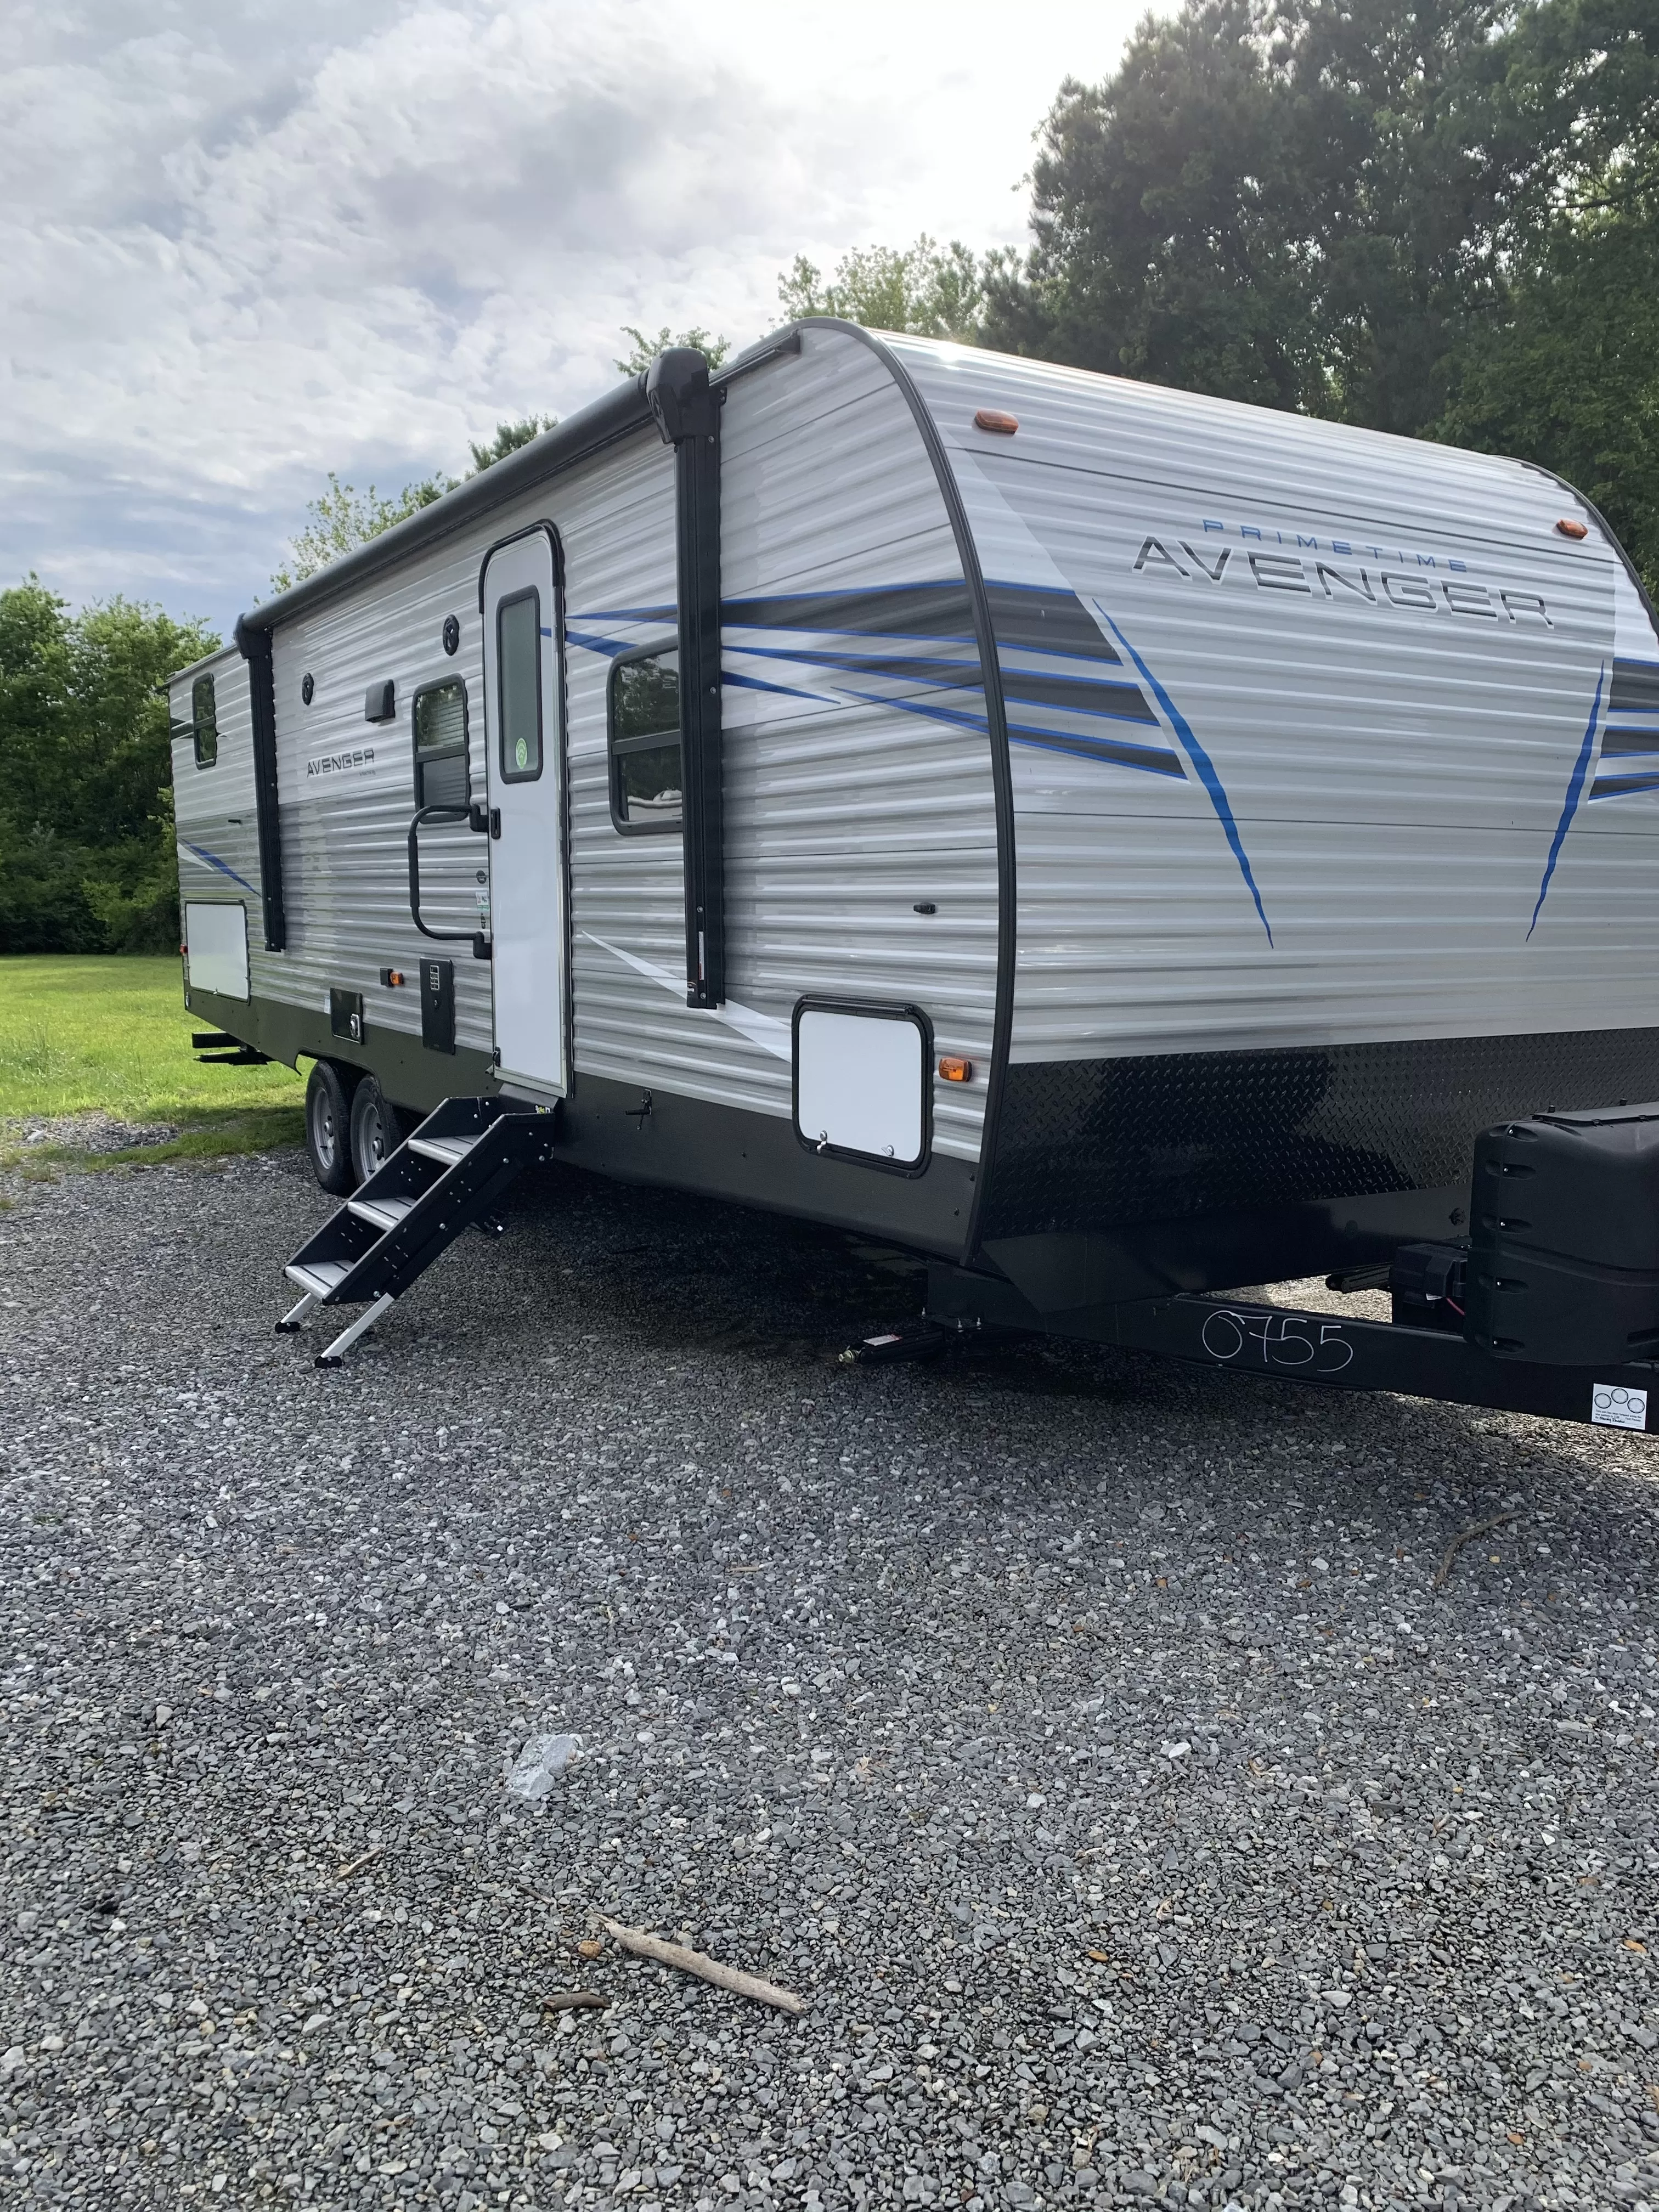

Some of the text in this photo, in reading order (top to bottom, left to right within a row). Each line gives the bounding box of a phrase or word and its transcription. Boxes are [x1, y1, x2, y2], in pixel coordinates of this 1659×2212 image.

[1202, 519, 1467, 573] PRIMETIME
[1132, 535, 1554, 629] AVENGER
[307, 748, 374, 777] AVENGER
[1202, 1310, 1353, 1372] 0755
